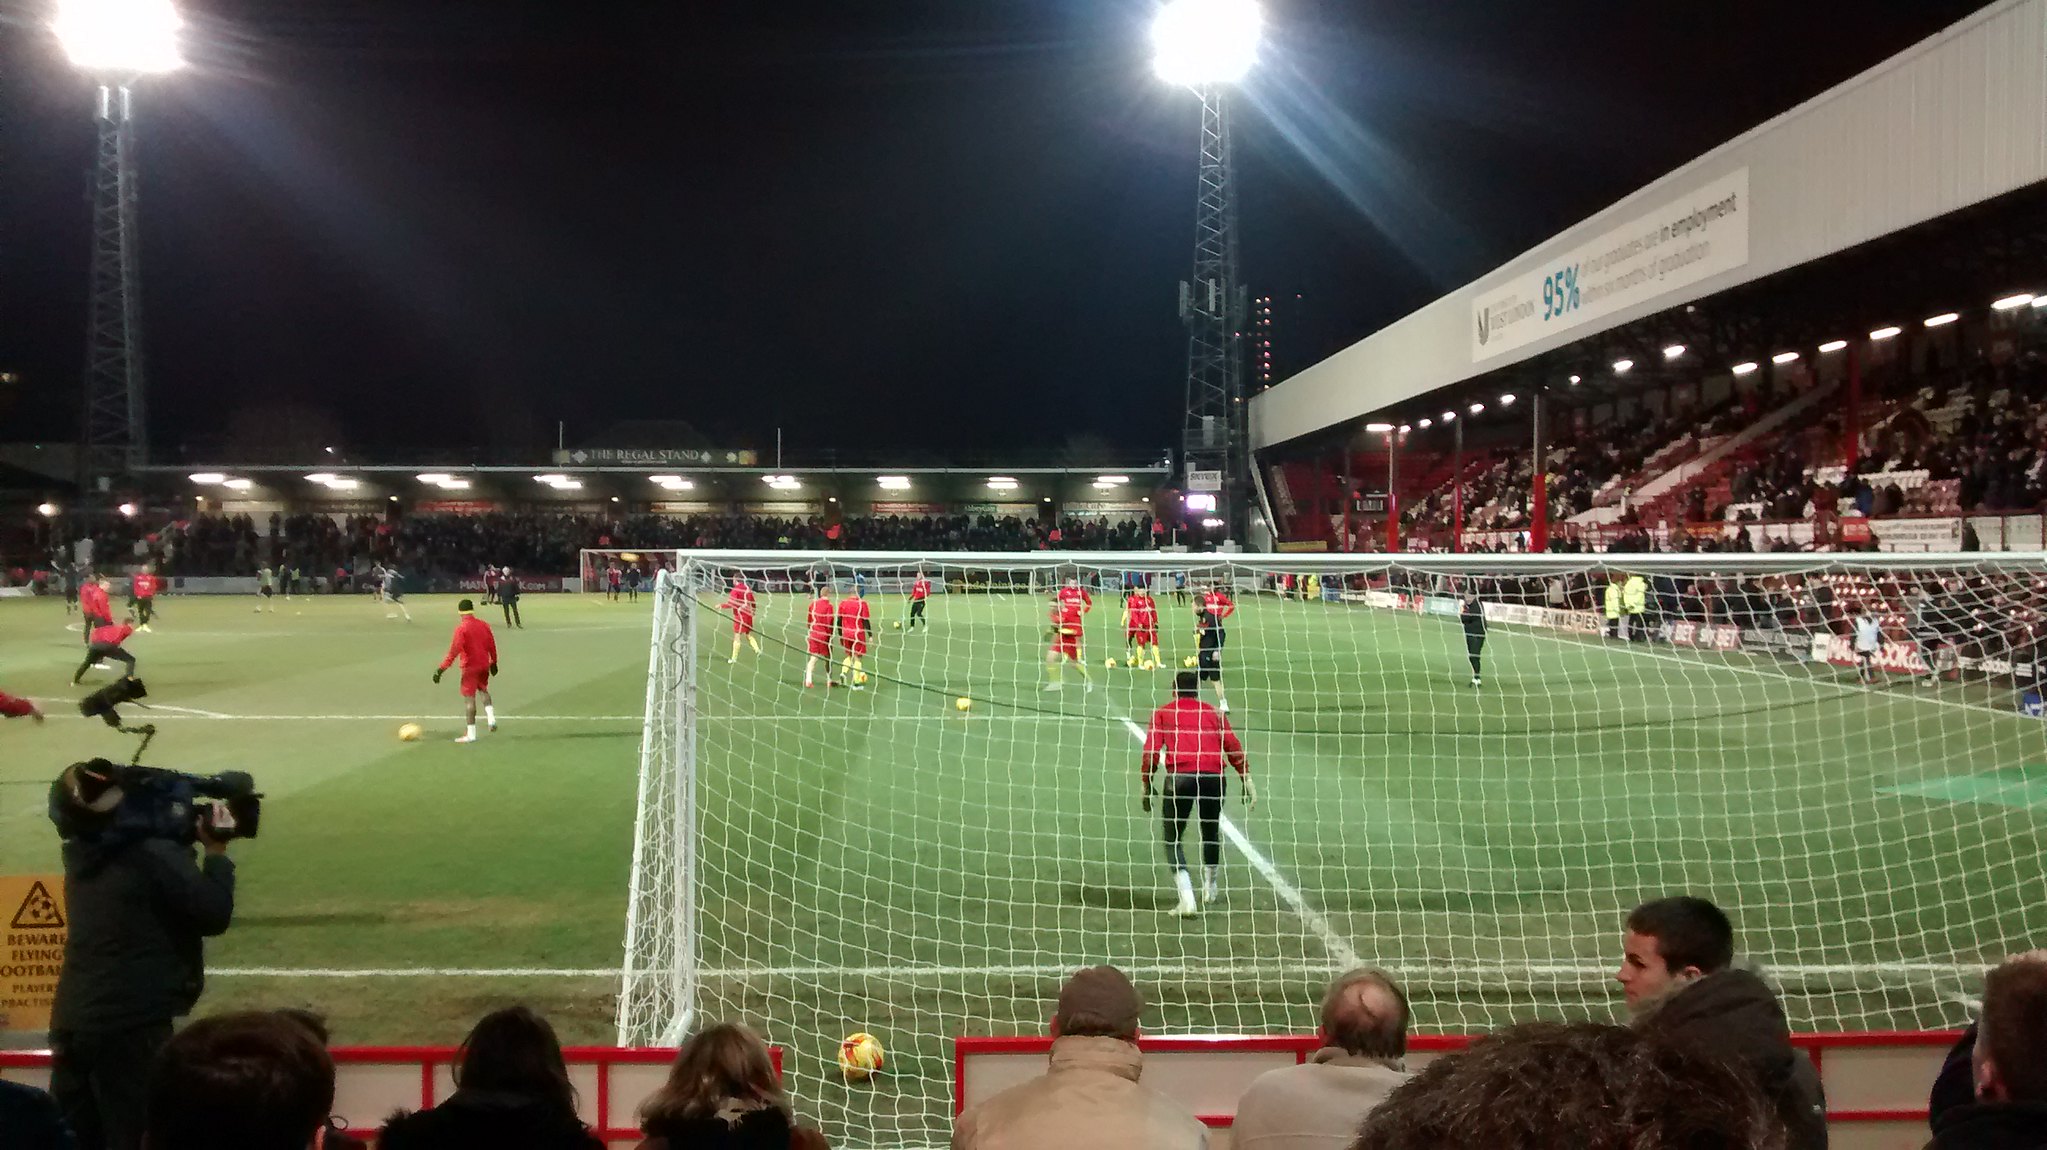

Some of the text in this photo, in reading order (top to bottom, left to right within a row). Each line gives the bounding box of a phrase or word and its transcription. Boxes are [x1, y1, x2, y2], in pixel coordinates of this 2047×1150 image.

[1543, 263, 1580, 321] 95%
[1670, 192, 1736, 238] employment
[592, 449, 699, 461] THE REGAL STAND
[1716, 628, 1738, 648] BET
[7, 933, 66, 946] BEWARE
[12, 950, 63, 962] FLYING
